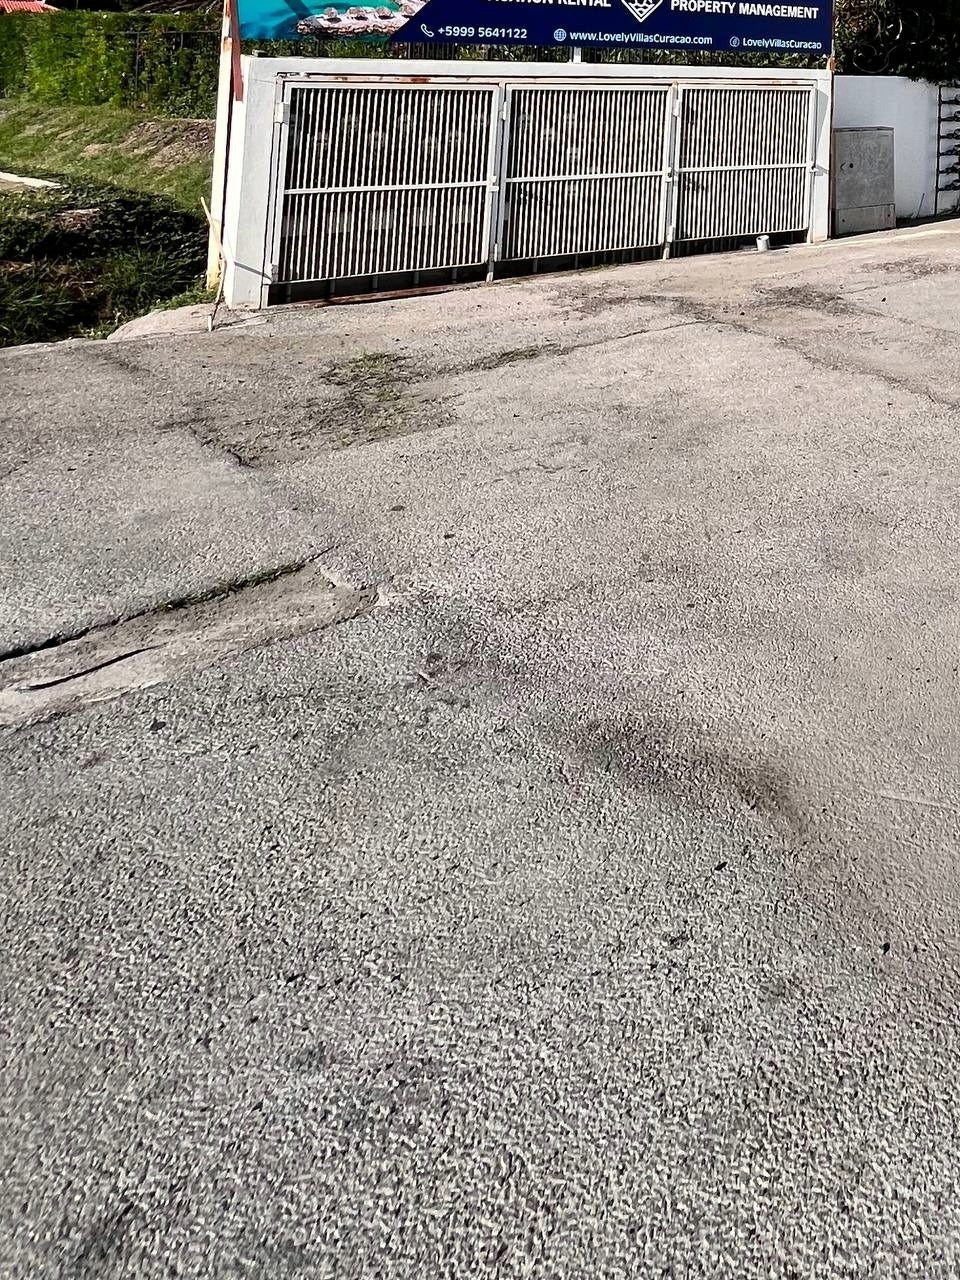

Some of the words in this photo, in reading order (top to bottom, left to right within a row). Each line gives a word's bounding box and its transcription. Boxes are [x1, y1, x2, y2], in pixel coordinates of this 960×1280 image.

[739, 2, 819, 19] MANAGEMENT
[437, 25, 475, 37] +5999
[478, 27, 528, 39] 5641122
[569, 30, 713, 45] www.LovelyVillasCuracao.com
[742, 37, 822, 50] LovelyVillasCuracao
